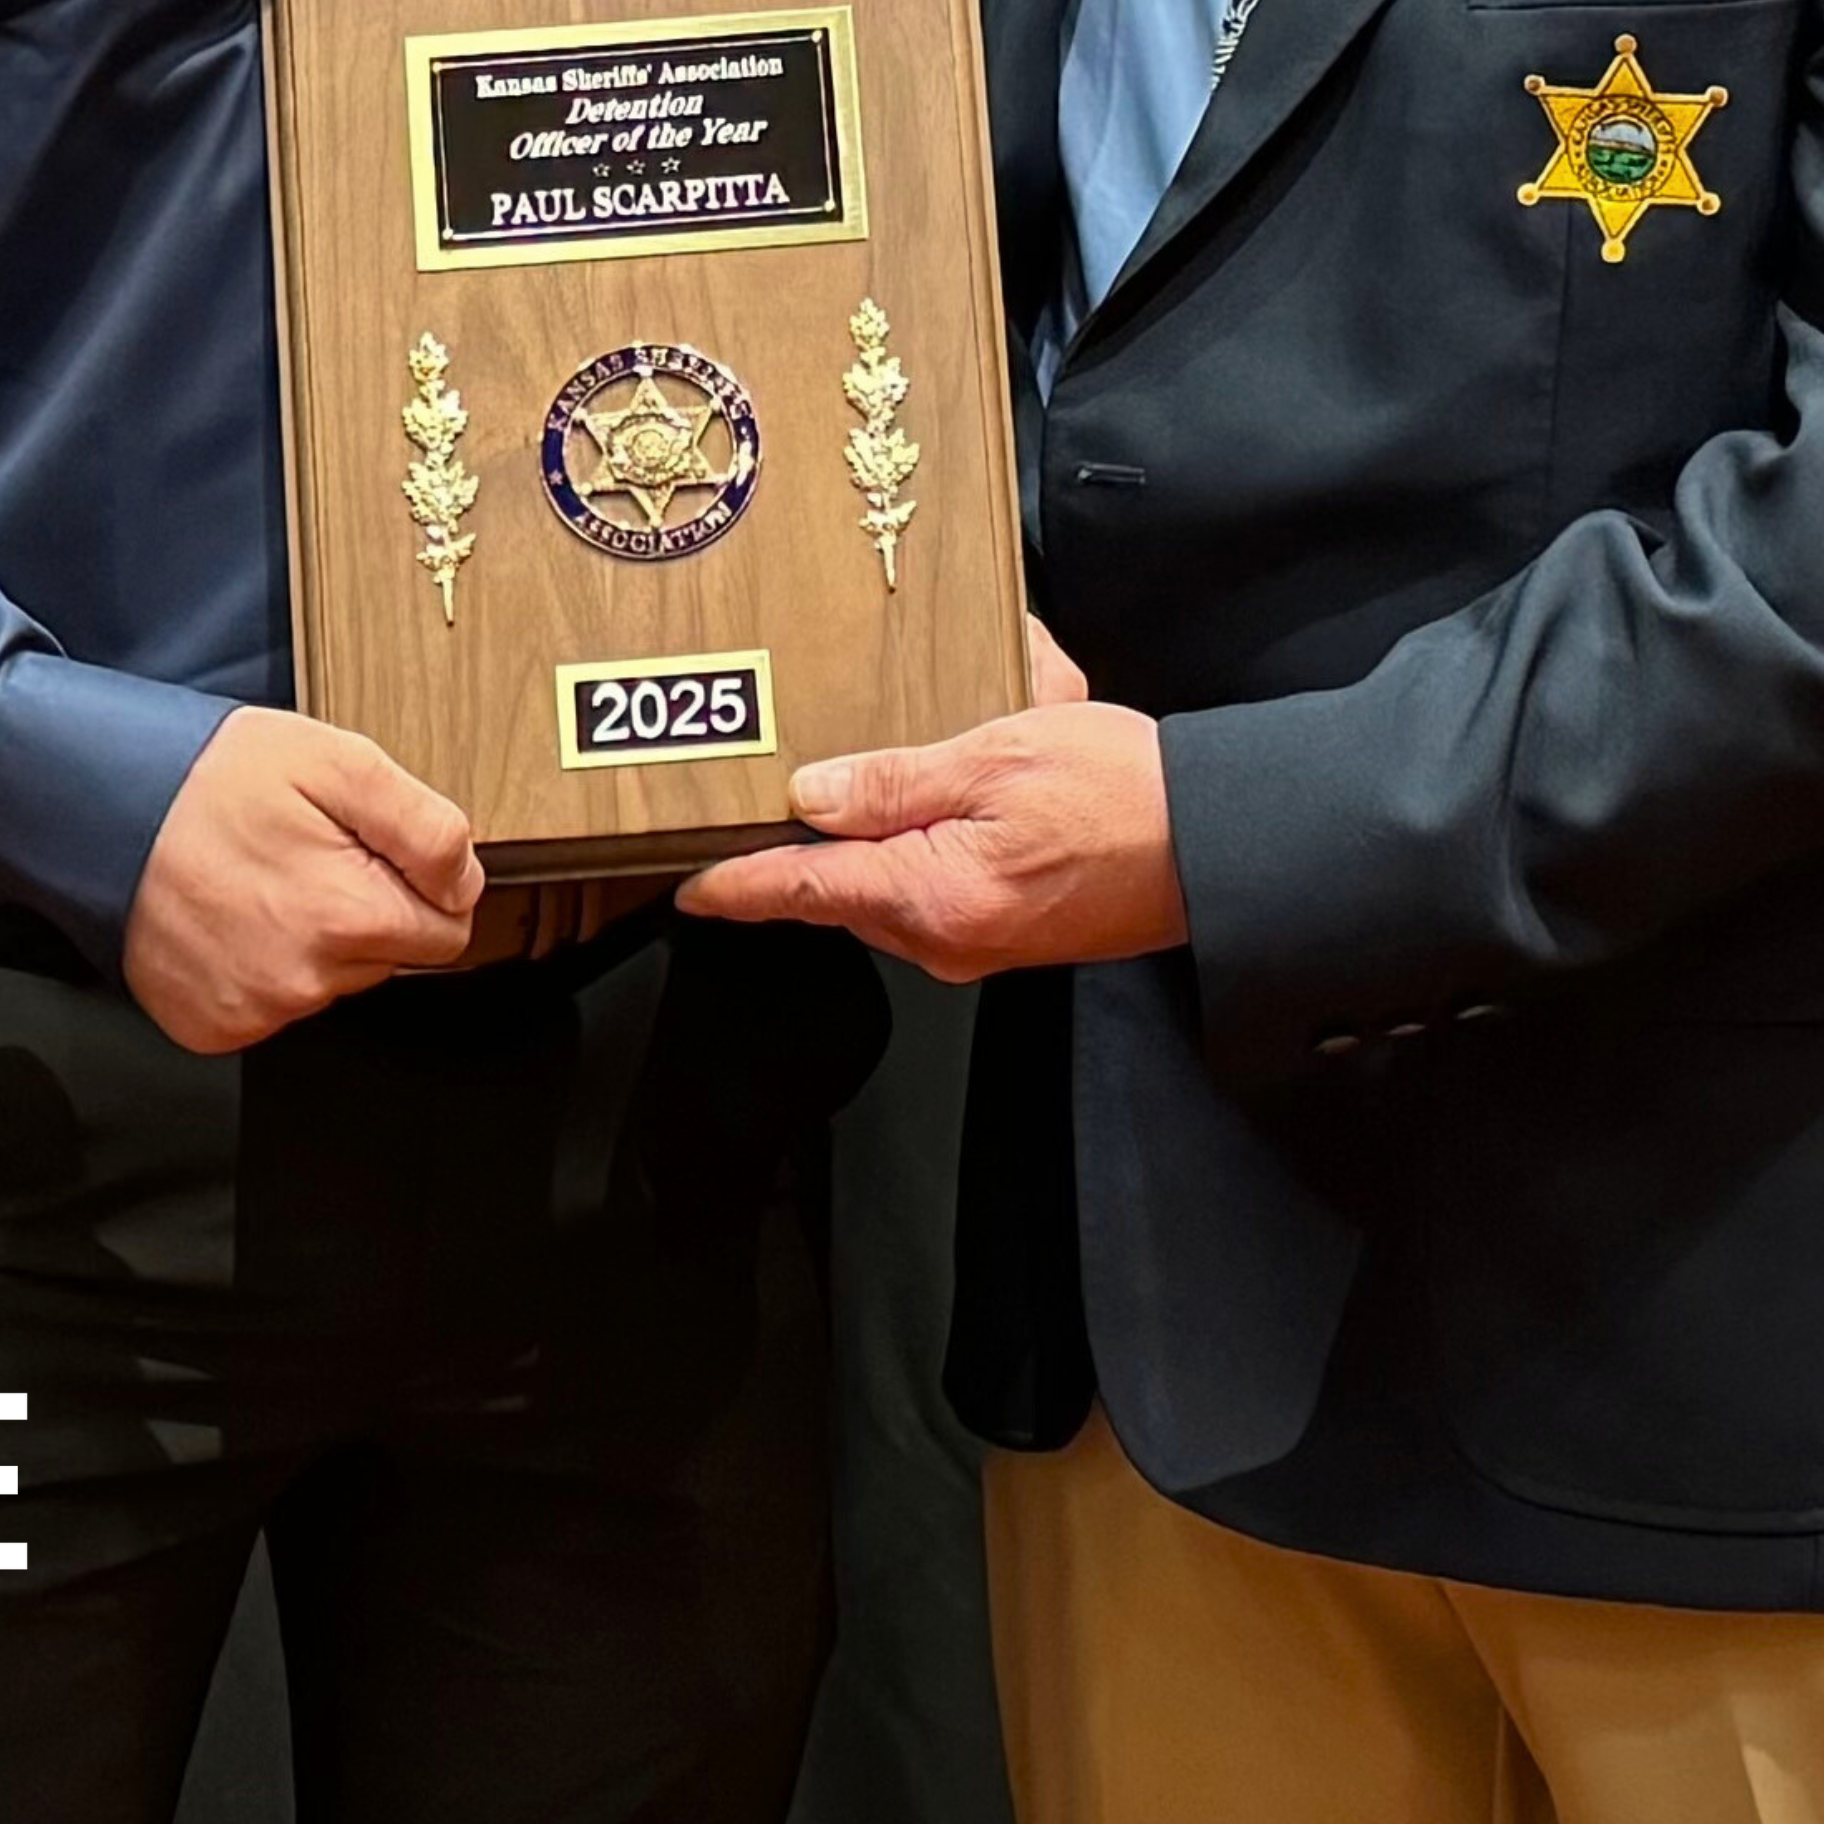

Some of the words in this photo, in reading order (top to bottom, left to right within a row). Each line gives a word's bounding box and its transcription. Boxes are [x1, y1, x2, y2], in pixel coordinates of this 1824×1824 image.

[475, 74, 557, 99] Kansas
[658, 54, 784, 85] Association
[564, 90, 704, 125] Detention
[509, 129, 609, 160] Officer
[612, 124, 646, 153] of
[646, 122, 693, 150] the
[700, 117, 769, 146] Year
[490, 187, 587, 226] PAUL
[592, 172, 791, 219] SCARPITTA
[547, 353, 625, 433] KANSAS
[592, 678, 746, 743] 2025
